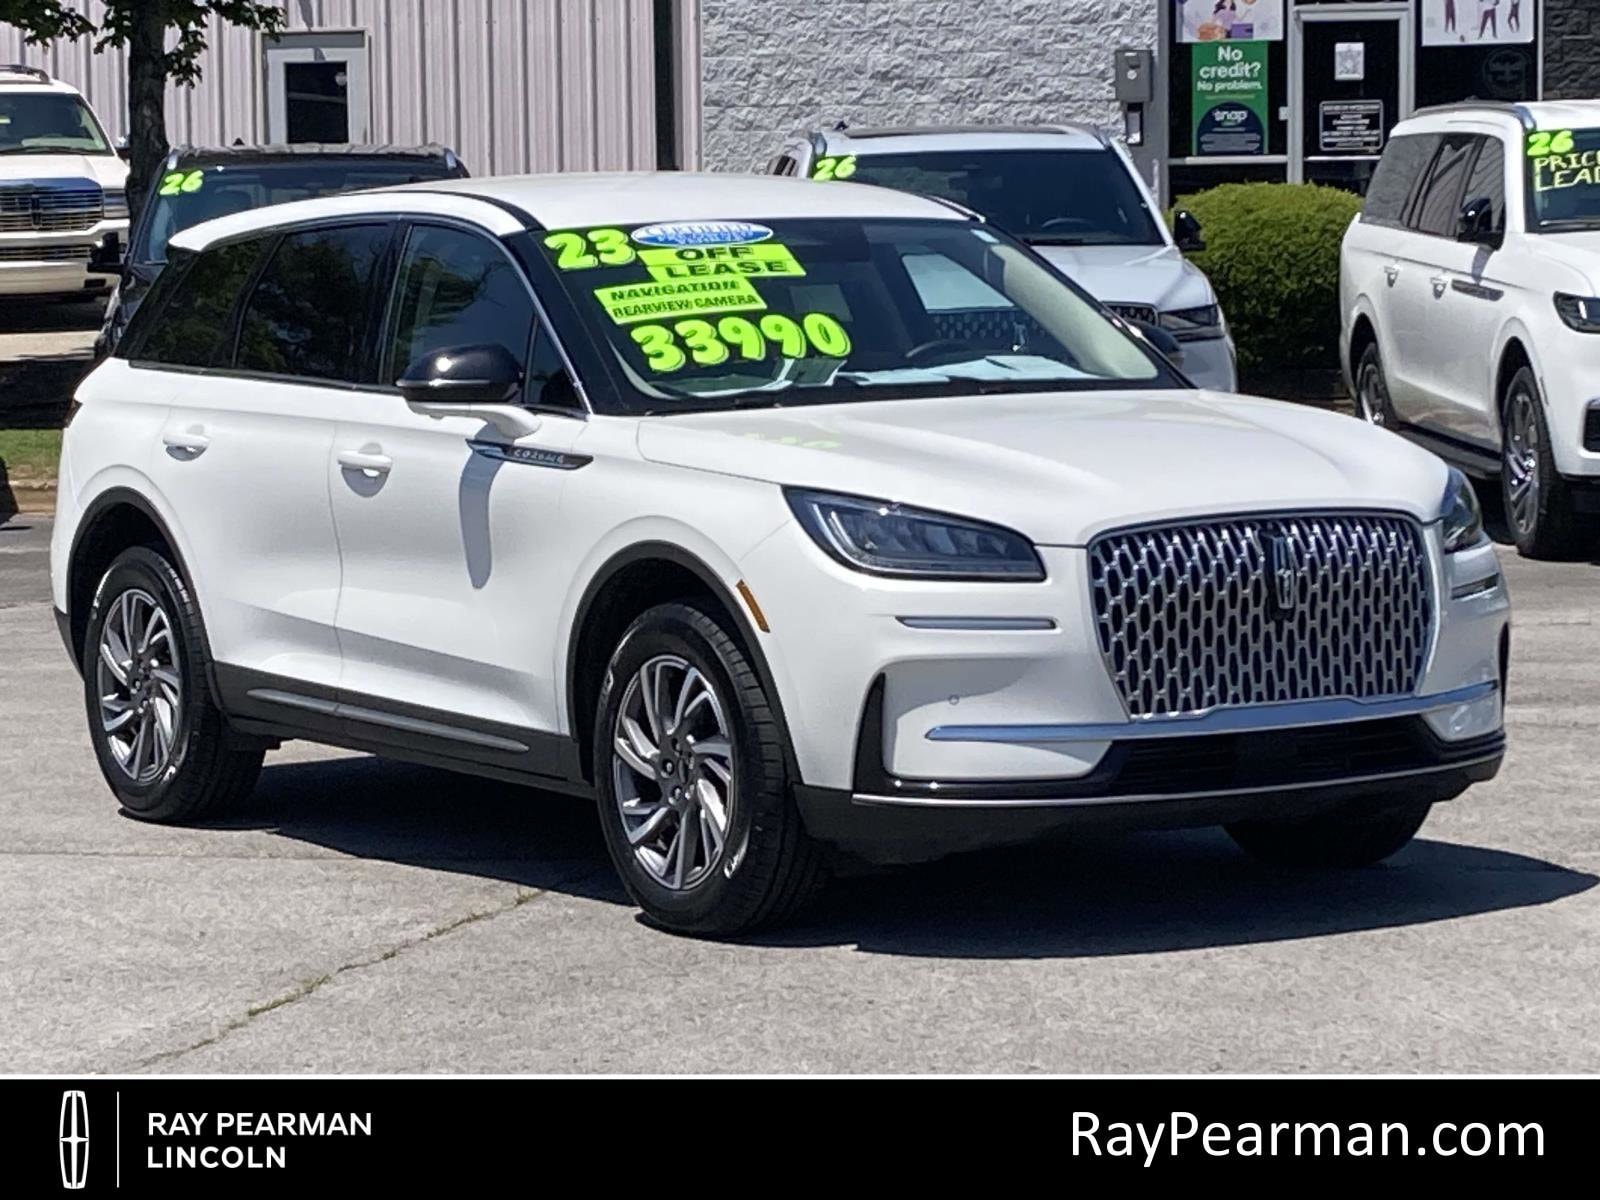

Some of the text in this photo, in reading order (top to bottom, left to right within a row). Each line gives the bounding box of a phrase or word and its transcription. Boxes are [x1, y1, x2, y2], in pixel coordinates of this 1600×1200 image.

[1217, 46, 1243, 61] No
[1199, 61, 1261, 78] credit?
[1196, 81, 1213, 91] No
[1527, 130, 1574, 156] 26
[813, 156, 856, 181] 26
[160, 170, 204, 195] 26
[545, 228, 637, 270] 23
[675, 247, 754, 261] OFF
[666, 261, 788, 278] LEASE
[610, 280, 740, 301] NAVIGATION
[612, 294, 759, 319] REARVIEW CAMERA
[631, 313, 851, 372] 33990
